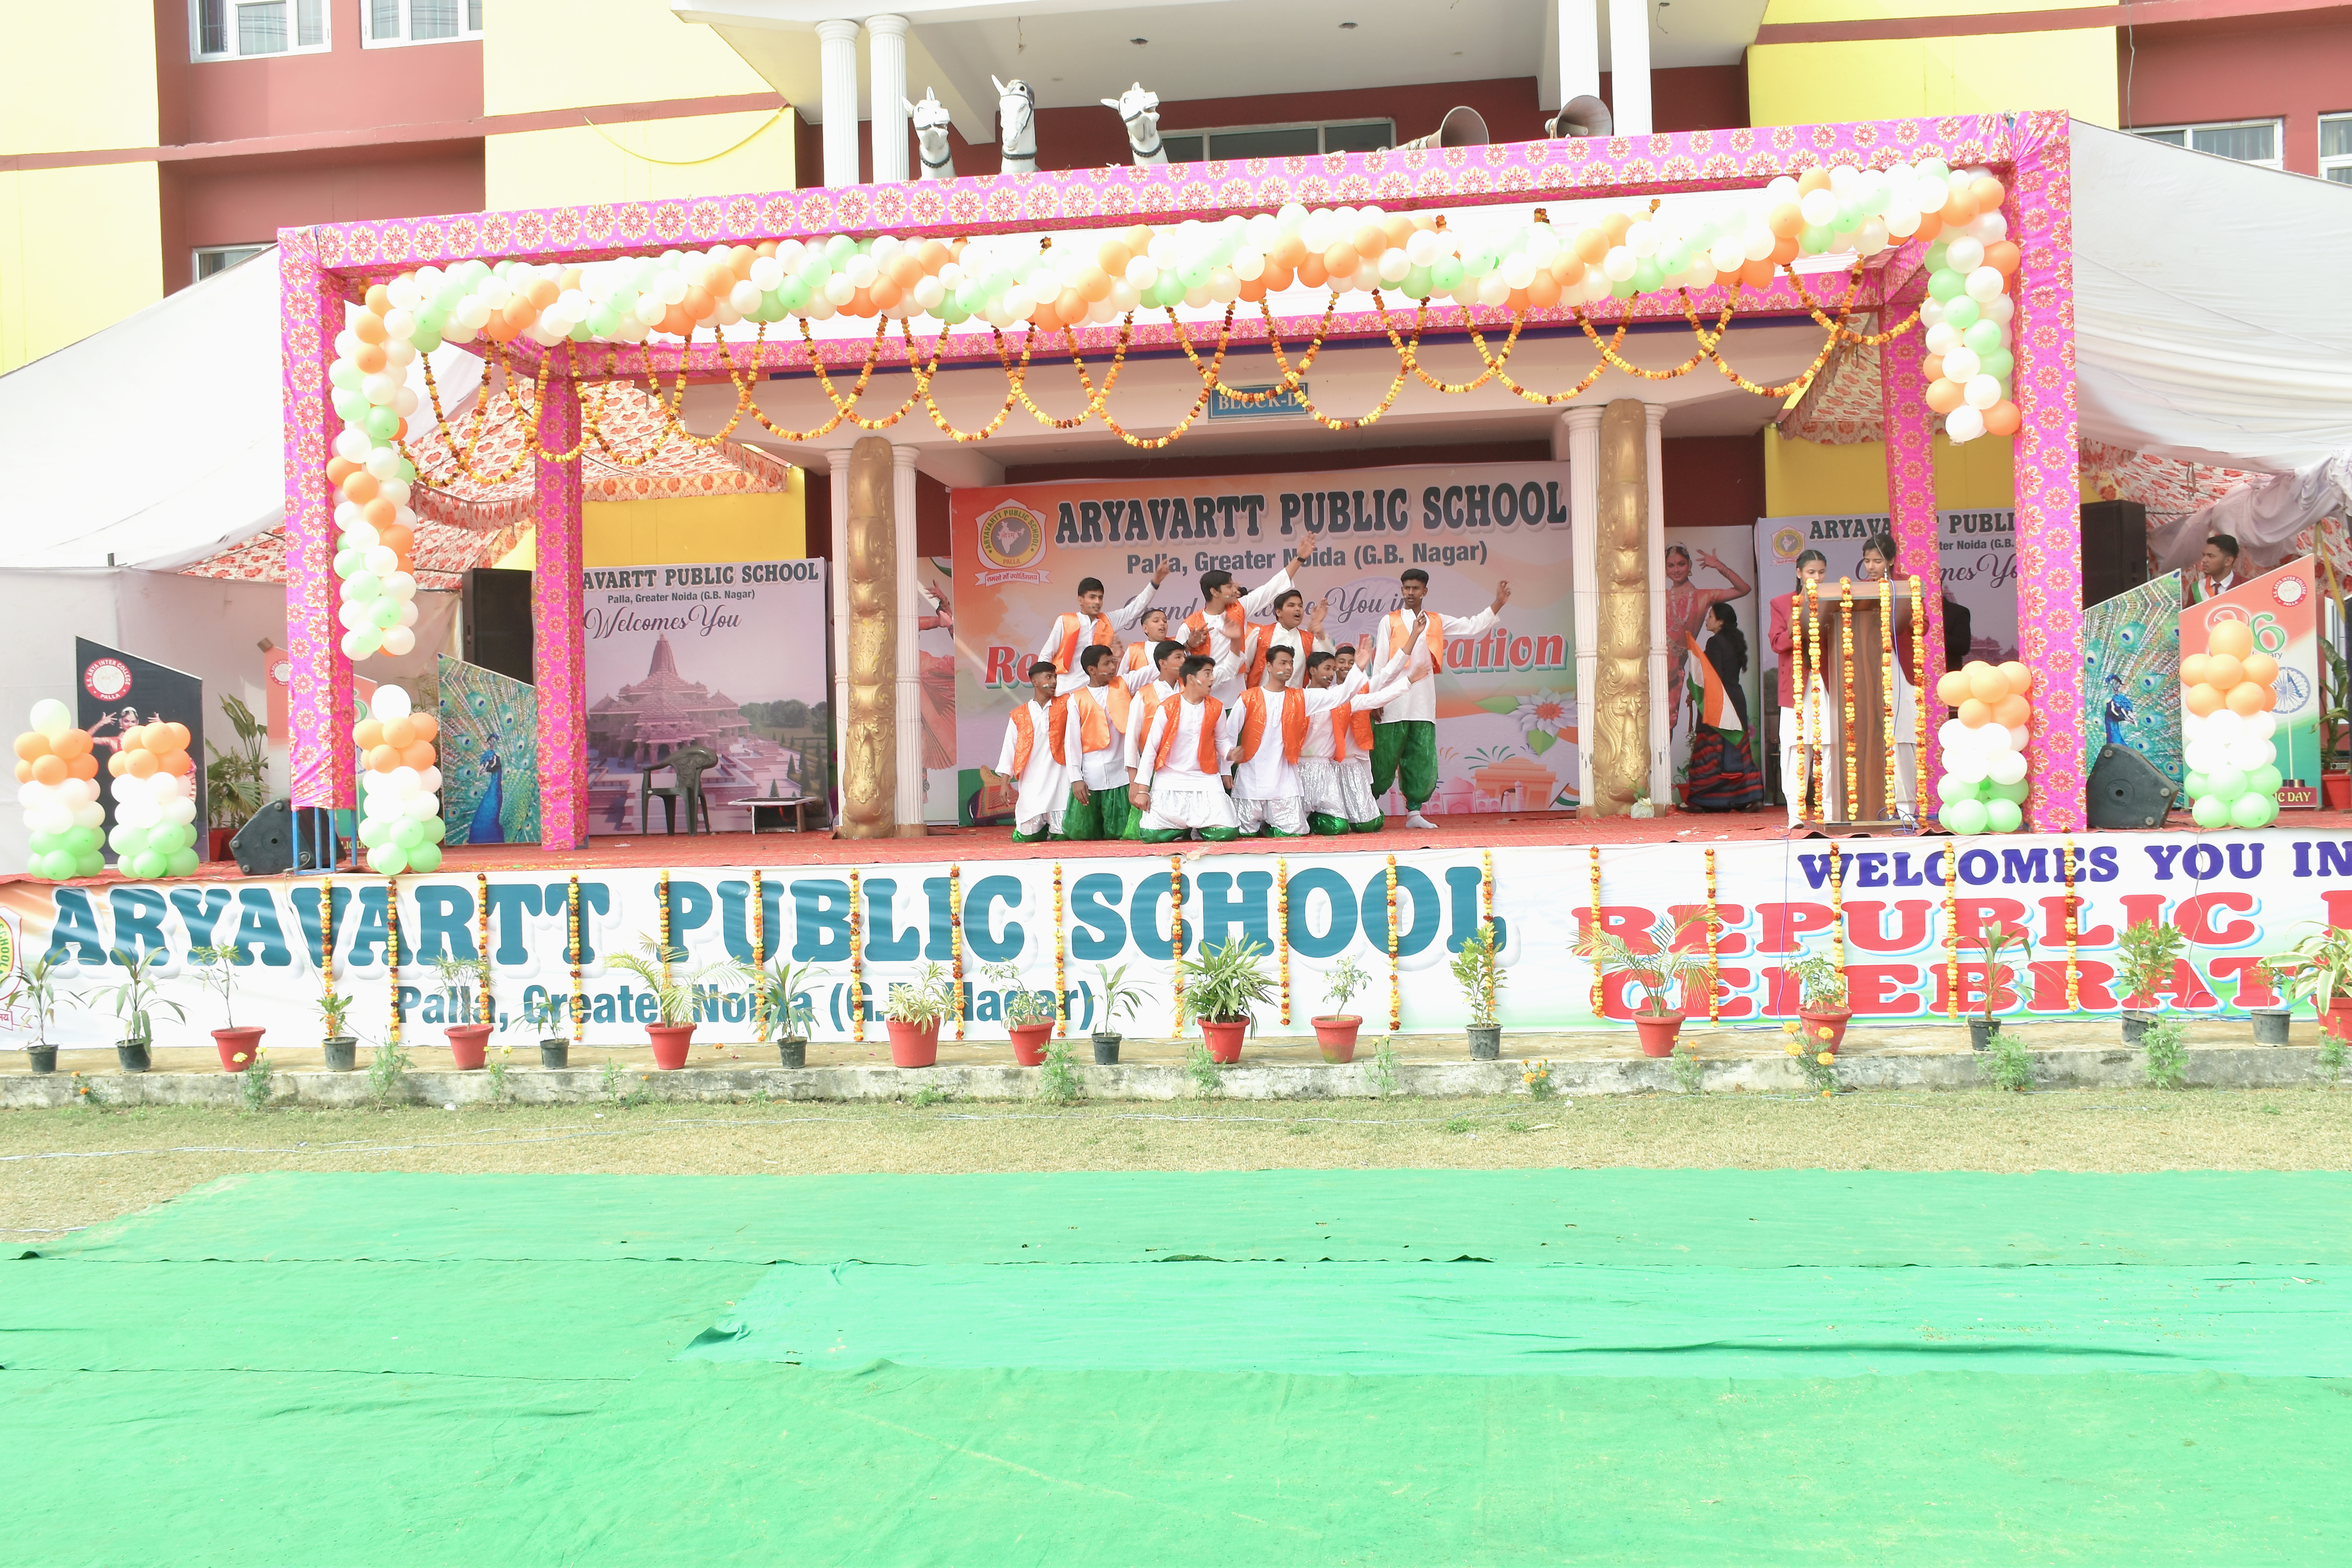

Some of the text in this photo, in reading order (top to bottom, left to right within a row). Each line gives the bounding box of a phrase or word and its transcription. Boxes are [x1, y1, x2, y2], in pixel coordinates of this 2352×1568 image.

[984, 510, 1039, 548] ARYAVARTT PUBLIC SCHOOL
[1055, 481, 1566, 544] ARYAVARTT PUBLIC SCHOOL
[1949, 513, 2014, 534] PUBLI
[1195, 550, 1276, 571] Greater
[1354, 545, 1403, 570] (G.B.
[1413, 541, 1487, 566] Nagar)
[1957, 540, 1986, 549] Noida
[1991, 539, 2014, 550] (G.B.
[584, 563, 818, 589] AVARTT PUBLIC SCHOOL
[1976, 554, 2017, 588] Yo
[608, 590, 755, 604] Palla, Greater Noida (G.B. Nagar)
[1324, 587, 1386, 623] You
[584, 604, 742, 639] Welcomes You
[87, 664, 99, 677] ARYA
[117, 663, 131, 685] COLLEGE
[2288, 792, 2311, 802] DAY
[1798, 846, 2117, 889] WELCOMES
[2144, 843, 2264, 880] YOU
[44, 866, 1506, 966] ARYAVARTT PUBLIC SCHOOL
[1571, 892, 2255, 956] REPUBLIC
[1590, 957, 2328, 1020] CELEBRAT
[397, 985, 508, 1033] Palla,
[523, 985, 662, 1024] Greate
[830, 982, 913, 1032] (G.
